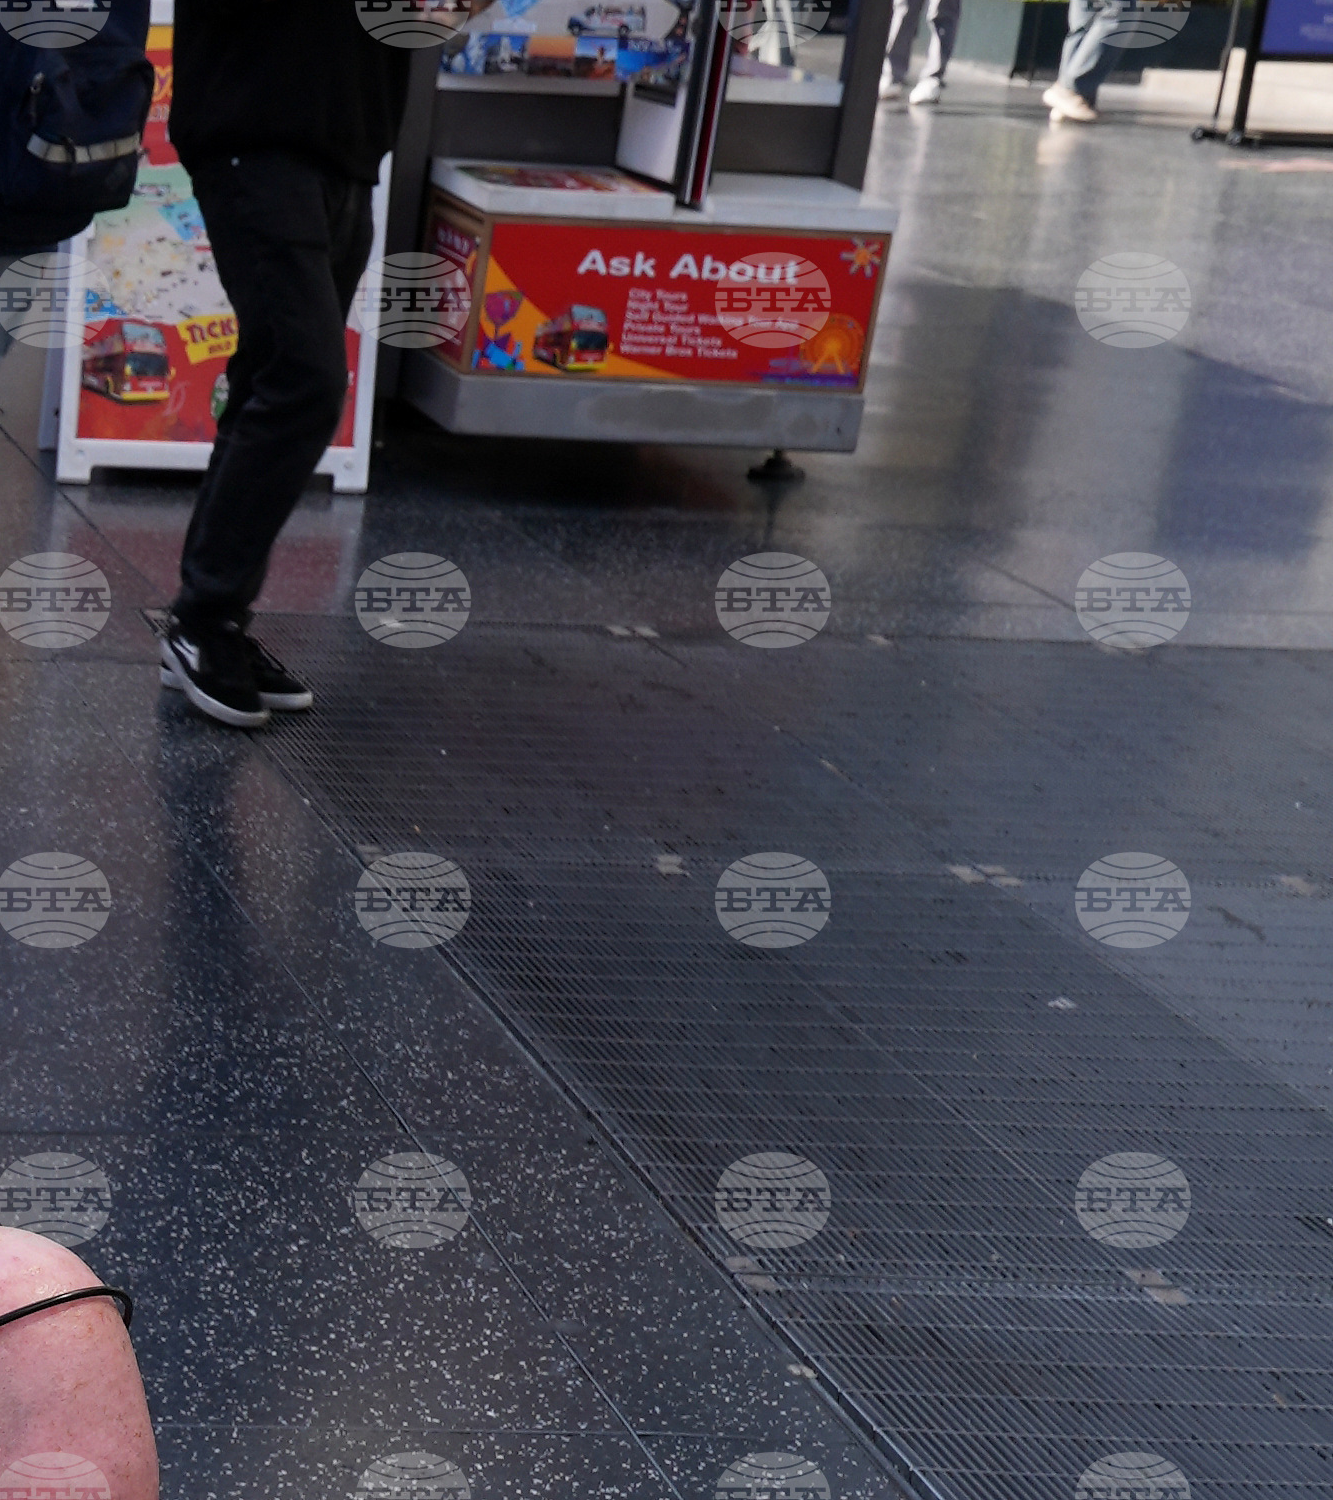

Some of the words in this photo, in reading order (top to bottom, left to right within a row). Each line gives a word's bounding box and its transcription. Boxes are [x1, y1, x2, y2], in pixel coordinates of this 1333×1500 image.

[577, 249, 656, 278] Ask
[669, 253, 801, 285] About
[186, 317, 238, 344] TICK
